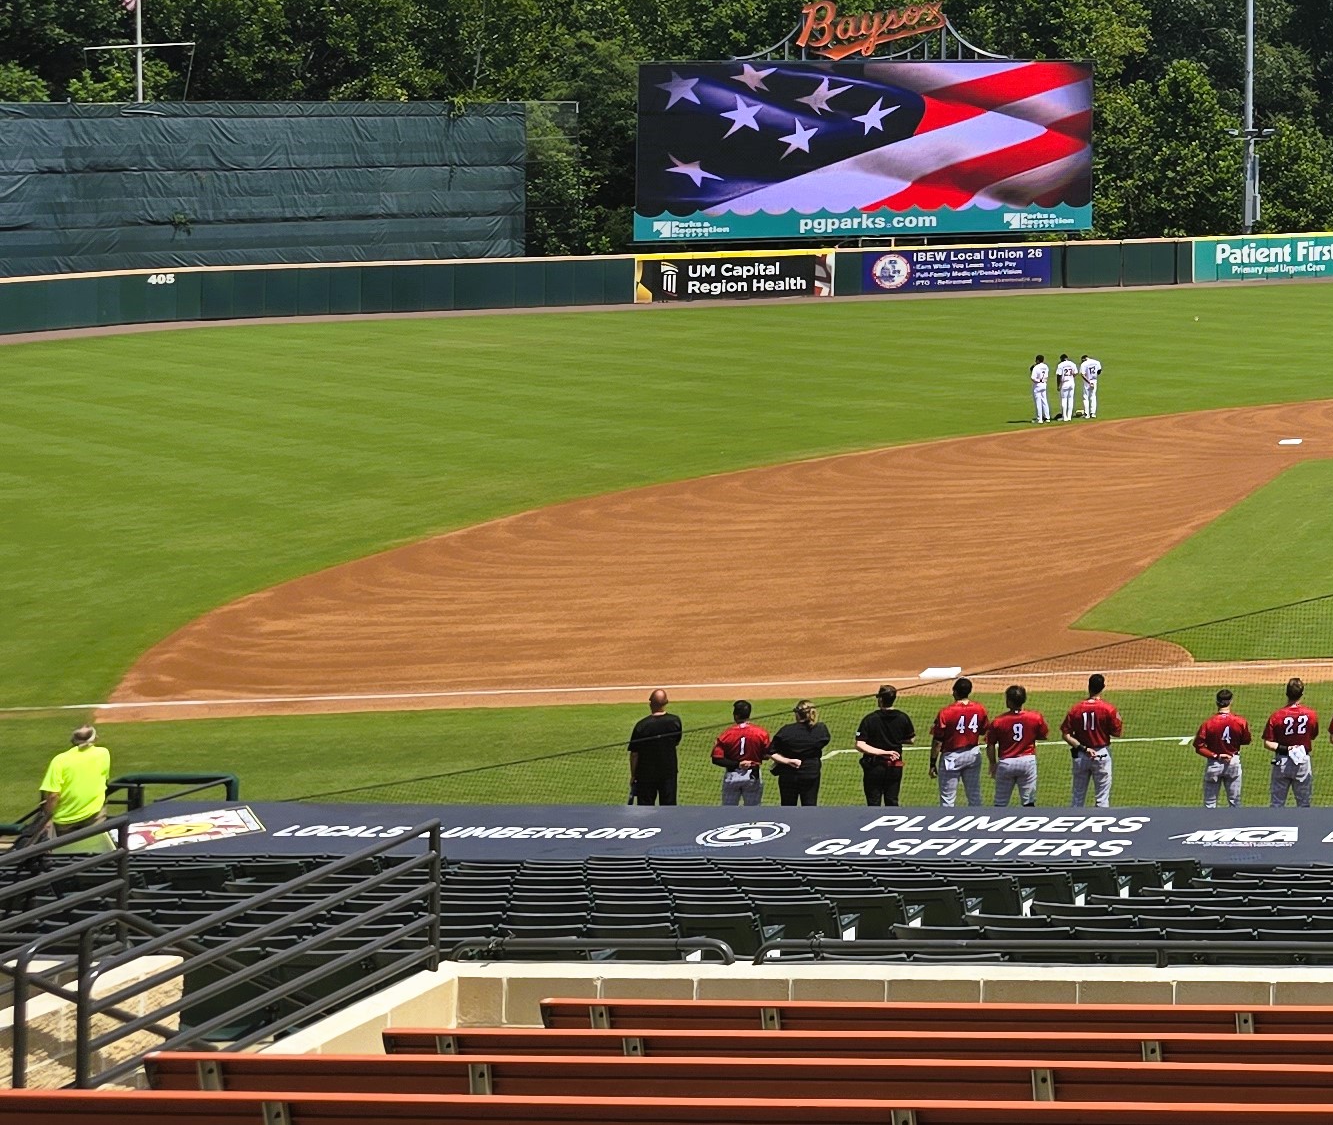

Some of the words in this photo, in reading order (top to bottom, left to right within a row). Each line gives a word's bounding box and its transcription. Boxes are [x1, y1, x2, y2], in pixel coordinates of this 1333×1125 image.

[796, 0, 946, 60] Baysox
[799, 213, 937, 233] pgparks.com
[913, 252, 947, 262] IBEW
[951, 250, 985, 261] Local
[988, 249, 1024, 260] Union
[1027, 248, 1043, 259] 26
[1216, 243, 1292, 265] Patient
[688, 265, 716, 277] UM
[721, 262, 780, 279] Capital
[1231, 265, 1263, 275] Primary
[1264, 264, 1279, 273] and
[1280, 263, 1306, 275] Urgent
[147, 274, 175, 284] 405
[688, 279, 748, 295] Region
[753, 277, 807, 292] Health
[956, 714, 978, 734] 44
[1082, 712, 1095, 732] 11
[1283, 714, 1309, 735] 22
[1012, 723, 1023, 742] 9
[1221, 725, 1231, 744] 4
[739, 736, 746, 756] 1
[859, 815, 1151, 833] PLUMBERS
[804, 838, 1133, 857] GASFITTERS
